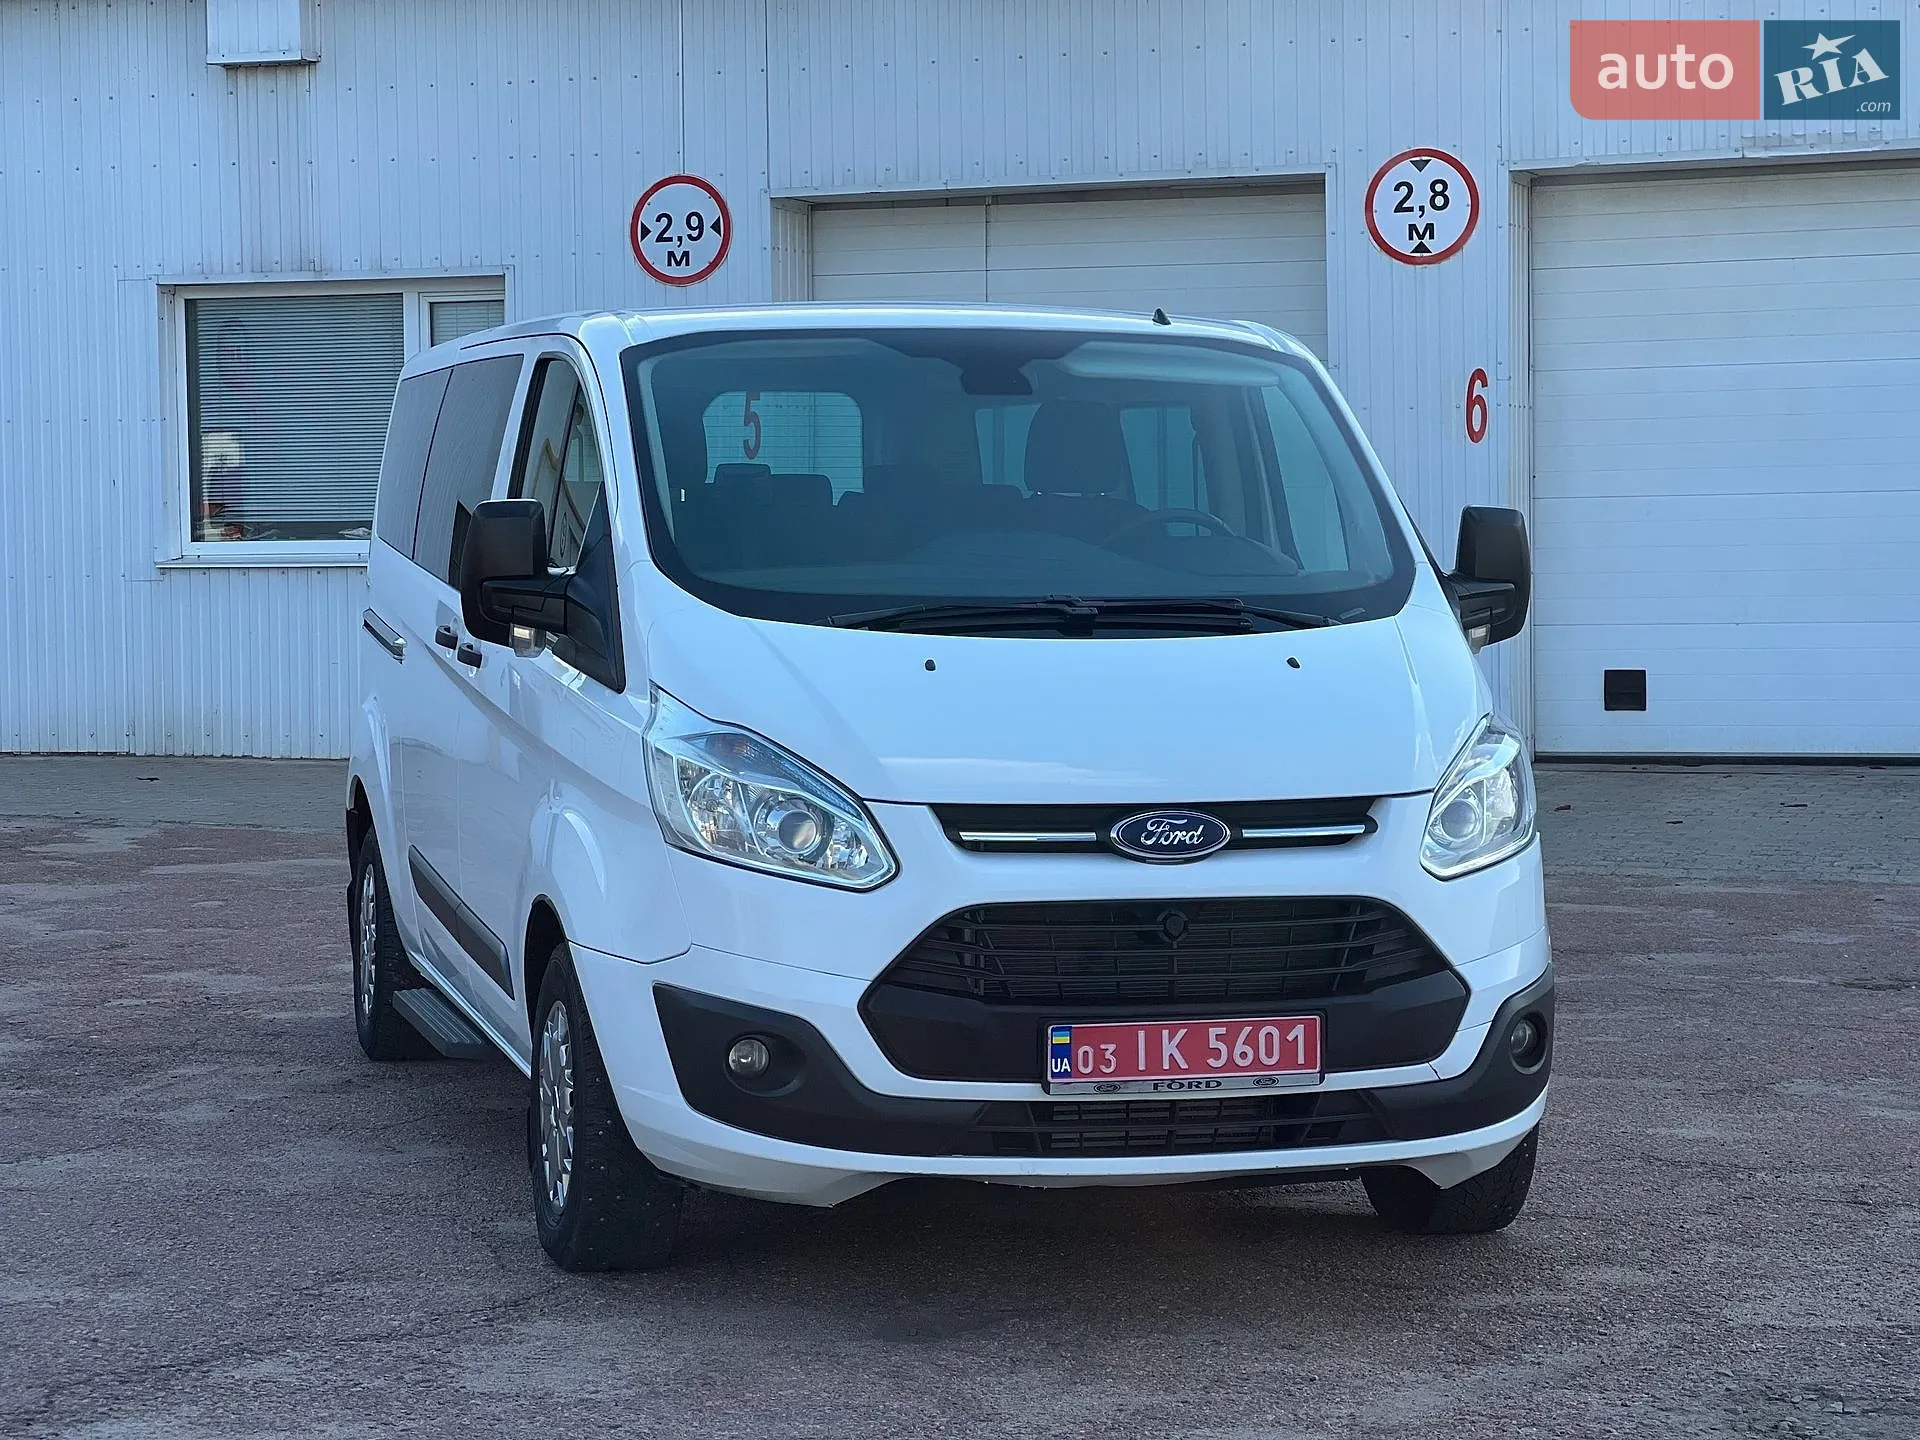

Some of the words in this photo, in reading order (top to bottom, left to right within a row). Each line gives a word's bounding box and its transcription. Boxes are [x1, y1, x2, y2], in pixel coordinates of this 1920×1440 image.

[1393, 178, 1450, 218] 2,8
[655, 211, 704, 248] 2,9
[1466, 368, 1488, 443] 6
[743, 391, 761, 460] 5
[1141, 818, 1204, 845] Ford
[1051, 1058, 1071, 1072] UA
[1077, 1044, 1117, 1074] 03
[1206, 1025, 1306, 1067] 5601
[1152, 1079, 1223, 1091] FORD
